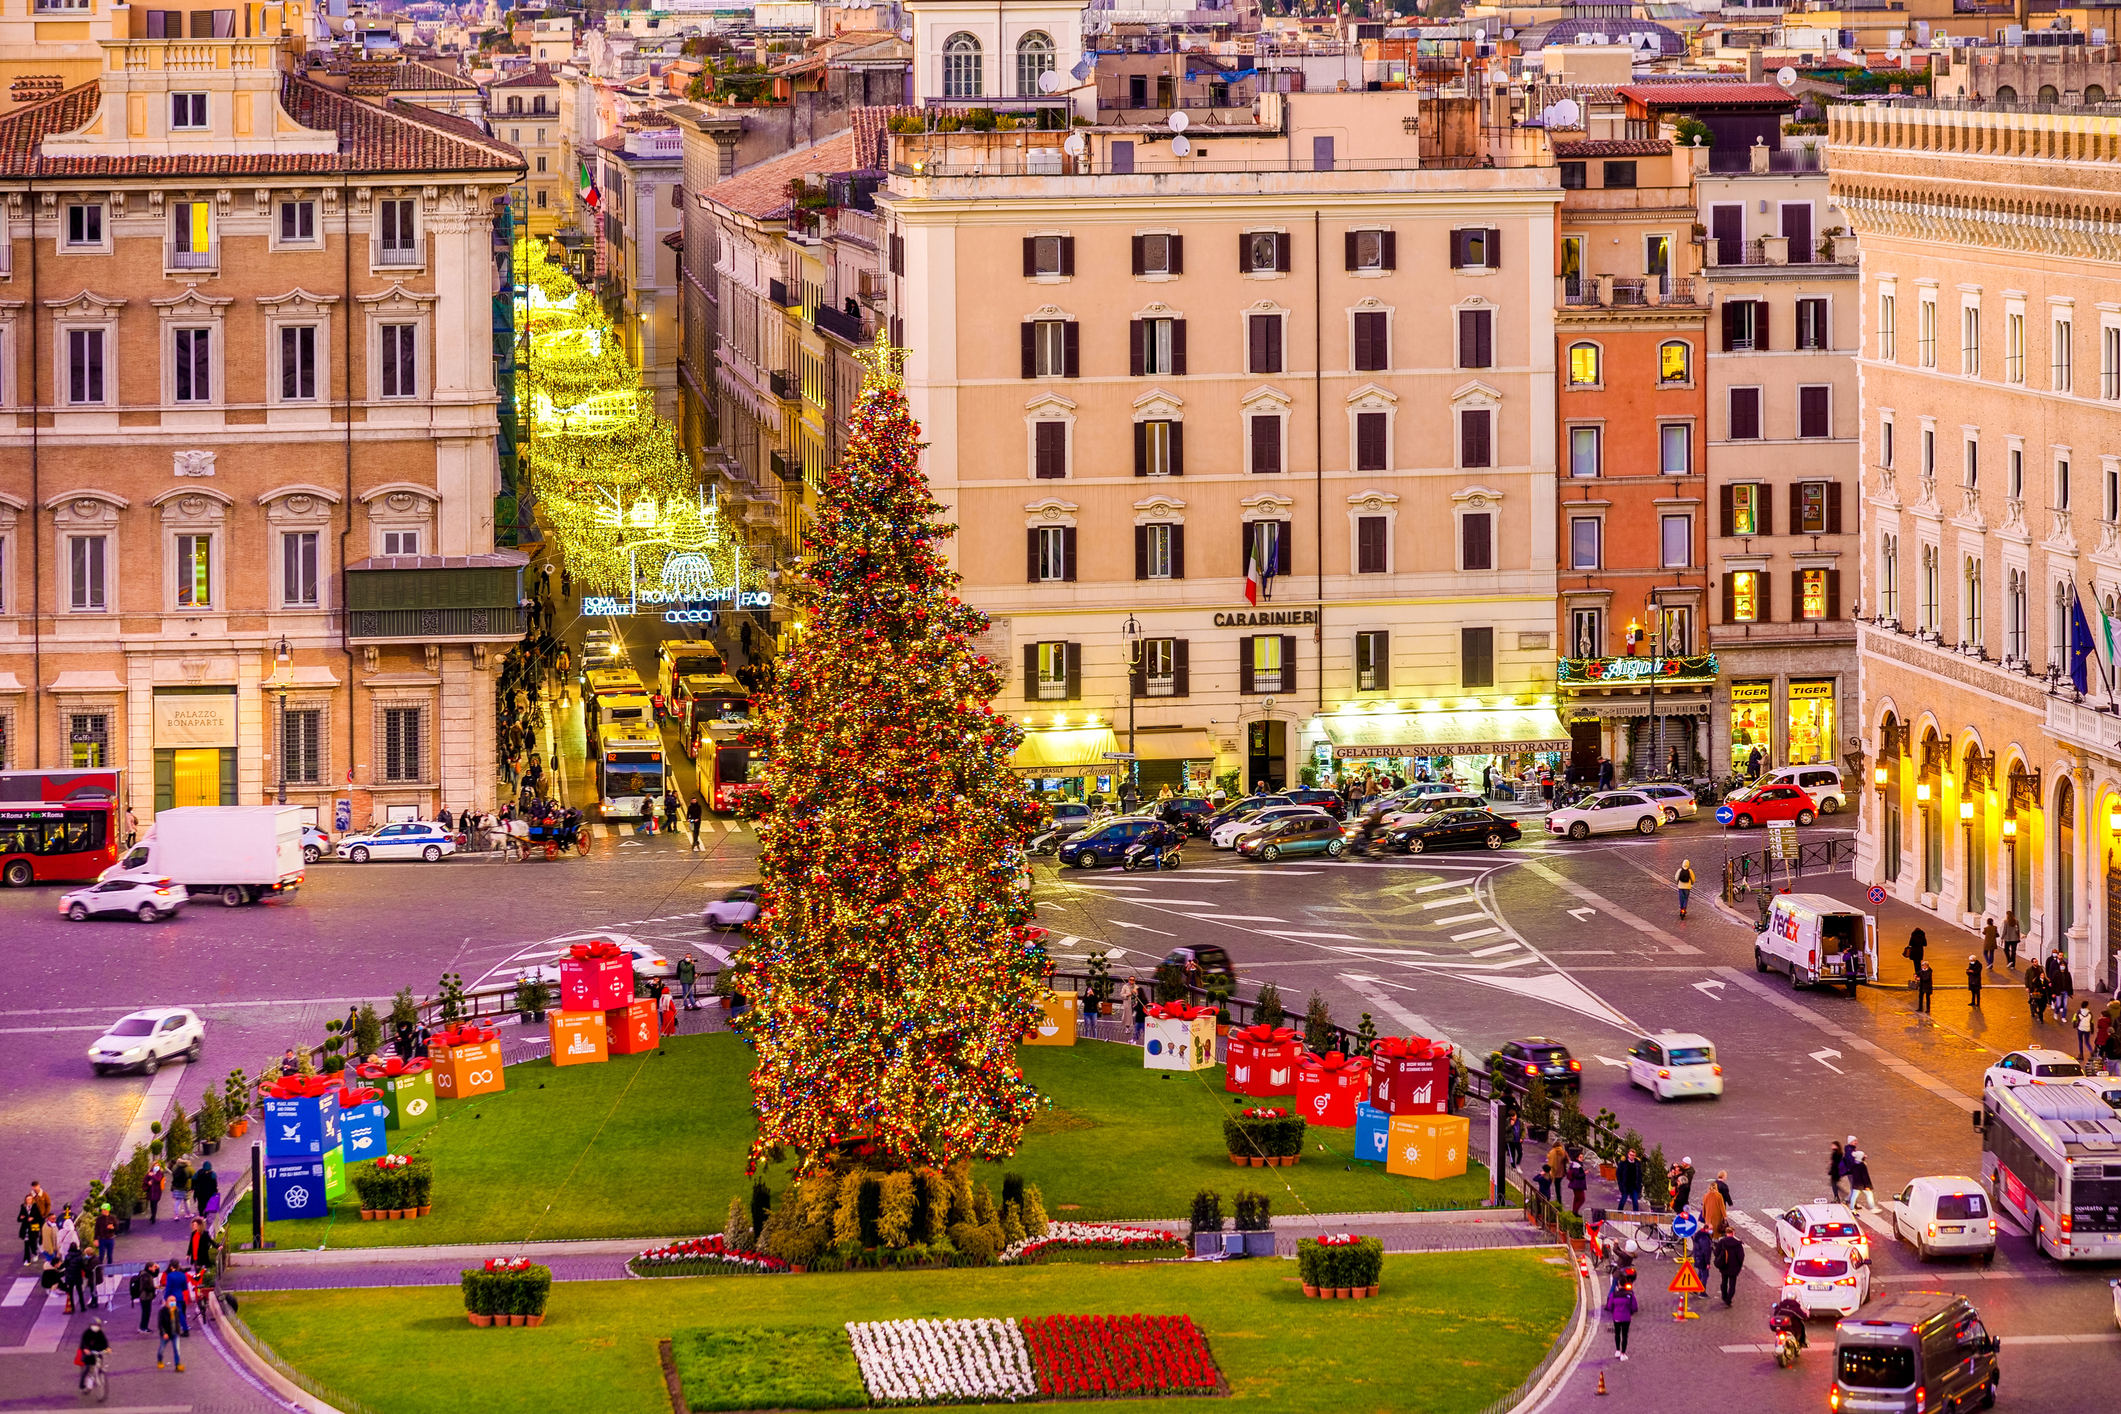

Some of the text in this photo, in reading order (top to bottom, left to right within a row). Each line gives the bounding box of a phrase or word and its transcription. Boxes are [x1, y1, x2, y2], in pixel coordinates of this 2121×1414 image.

[642, 589, 682, 604] ROMA
[694, 586, 734, 602] LIGHT
[742, 592, 772, 606] FAO
[584, 597, 616, 606] ROMA
[584, 606, 630, 616] CAPITALE
[666, 610, 712, 623] acea
[1214, 610, 1318, 626] CARABINIERI
[1616, 706, 1646, 714] RESTAURANT
[1337, 742, 1570, 758] GELATERIA SNACK BAR RISTORANTE
[1079, 766, 1116, 776] Gelateria
[1772, 908, 1800, 943] FedEx
[561, 963, 568, 972] 10
[600, 962, 606, 971] 10
[557, 1019, 563, 1028] 11
[1229, 1042, 1232, 1051] 4
[455, 1050, 463, 1058] 12
[1261, 1048, 1266, 1057] 4
[1400, 1062, 1405, 1072] 8
[1299, 1072, 1304, 1081] 5
[396, 1080, 404, 1090] 13
[266, 1102, 275, 1111] 16
[1360, 1108, 1364, 1116] 6
[1391, 1121, 1395, 1130] 7
[268, 1168, 277, 1178] 17
